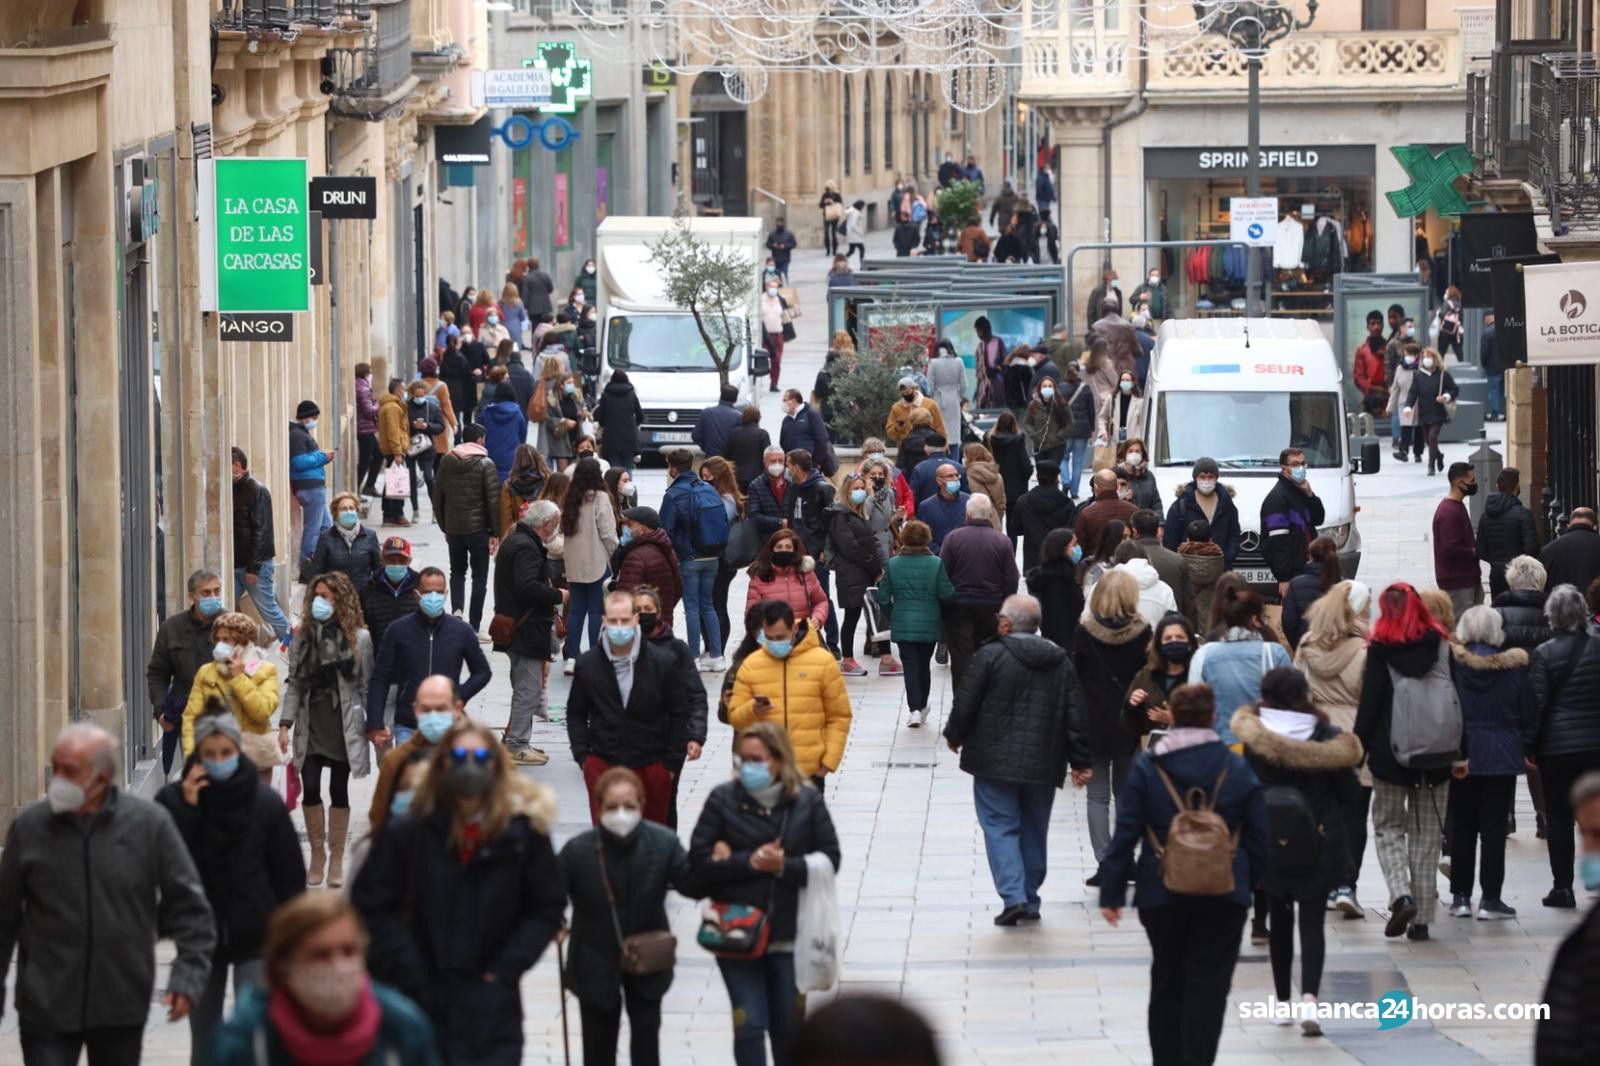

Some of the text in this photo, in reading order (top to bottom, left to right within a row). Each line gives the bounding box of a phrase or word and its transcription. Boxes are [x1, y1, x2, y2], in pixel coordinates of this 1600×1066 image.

[493, 72, 544, 82] ACADEMIA
[497, 84, 540, 94] GALILEO
[322, 191, 366, 205] DRUNI
[224, 198, 299, 214] LA CASA
[230, 225, 294, 242] DE LAS
[223, 253, 302, 270] CARCASAS
[1540, 323, 1600, 336] LA BOTIC
[1254, 363, 1304, 375] SEUR
